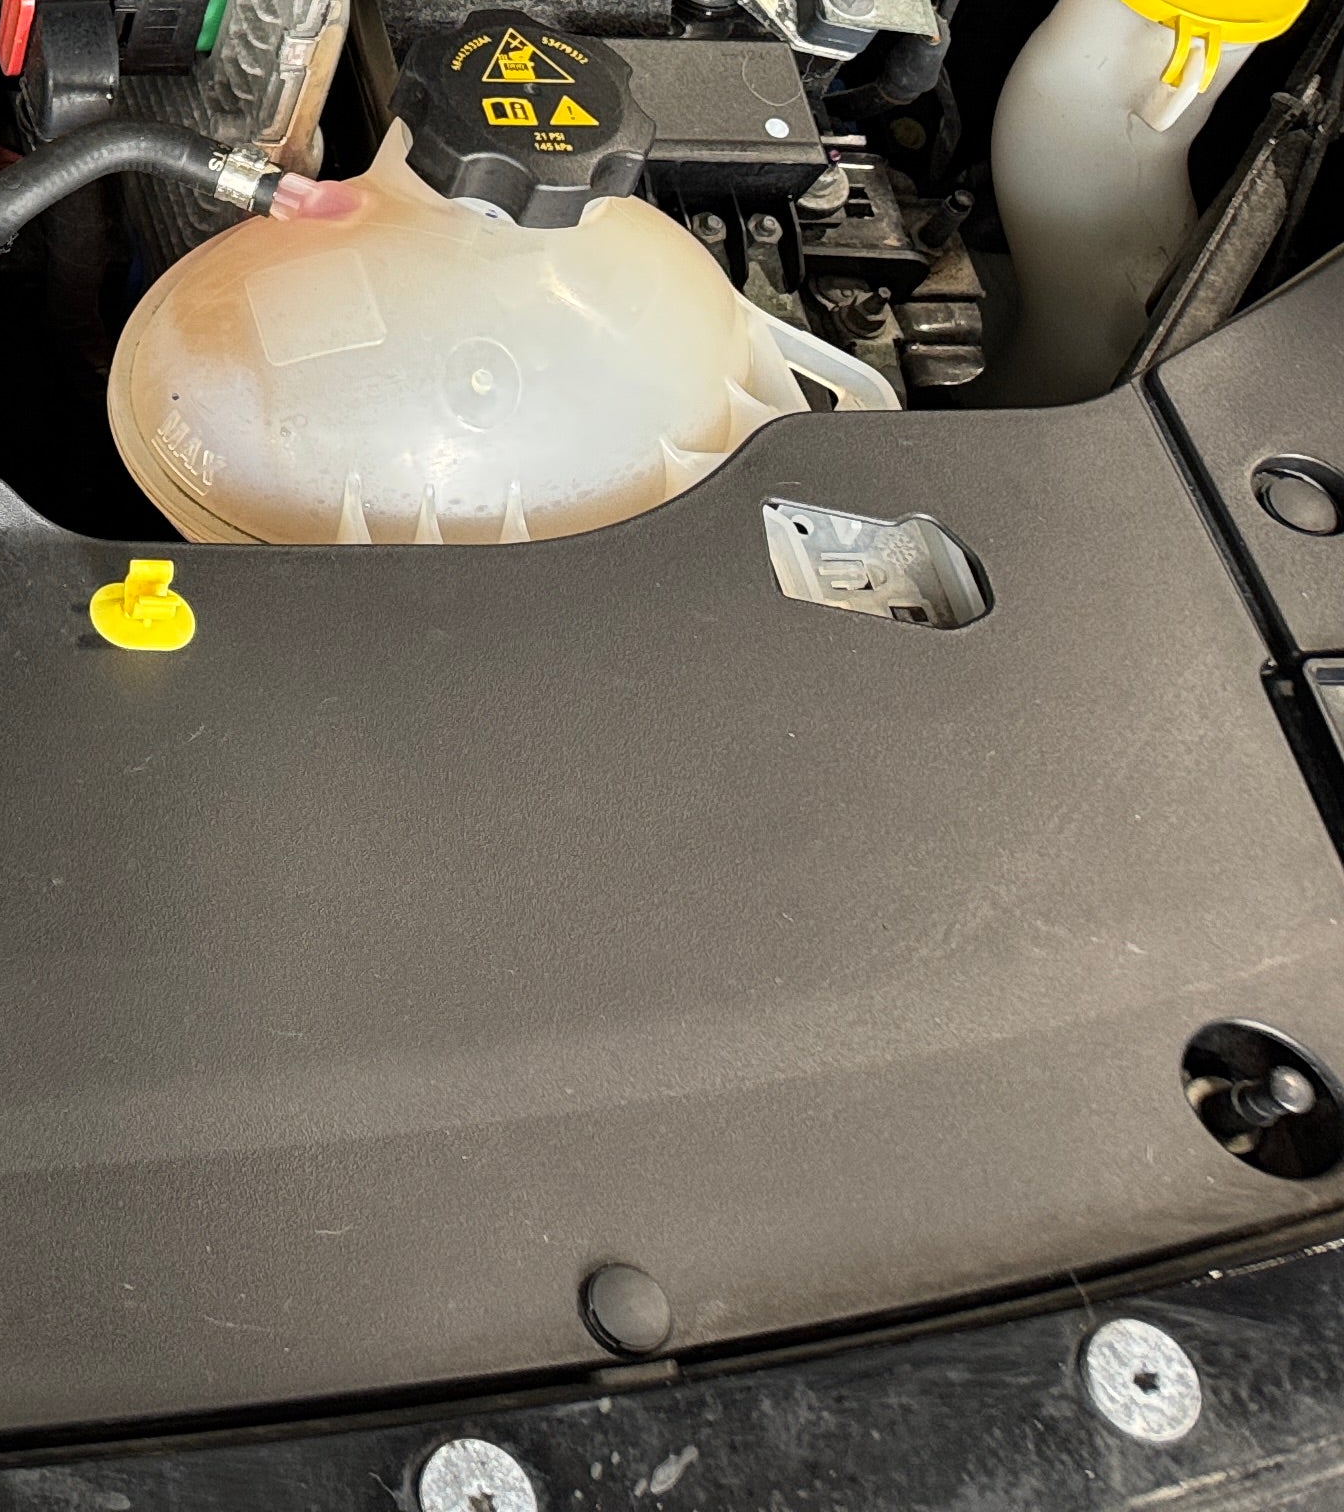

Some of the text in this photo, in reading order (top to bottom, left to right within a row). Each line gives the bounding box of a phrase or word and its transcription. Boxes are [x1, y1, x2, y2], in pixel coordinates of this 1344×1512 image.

[533, 131, 566, 142] 21 PSI
[533, 141, 574, 153] 145 kPa
